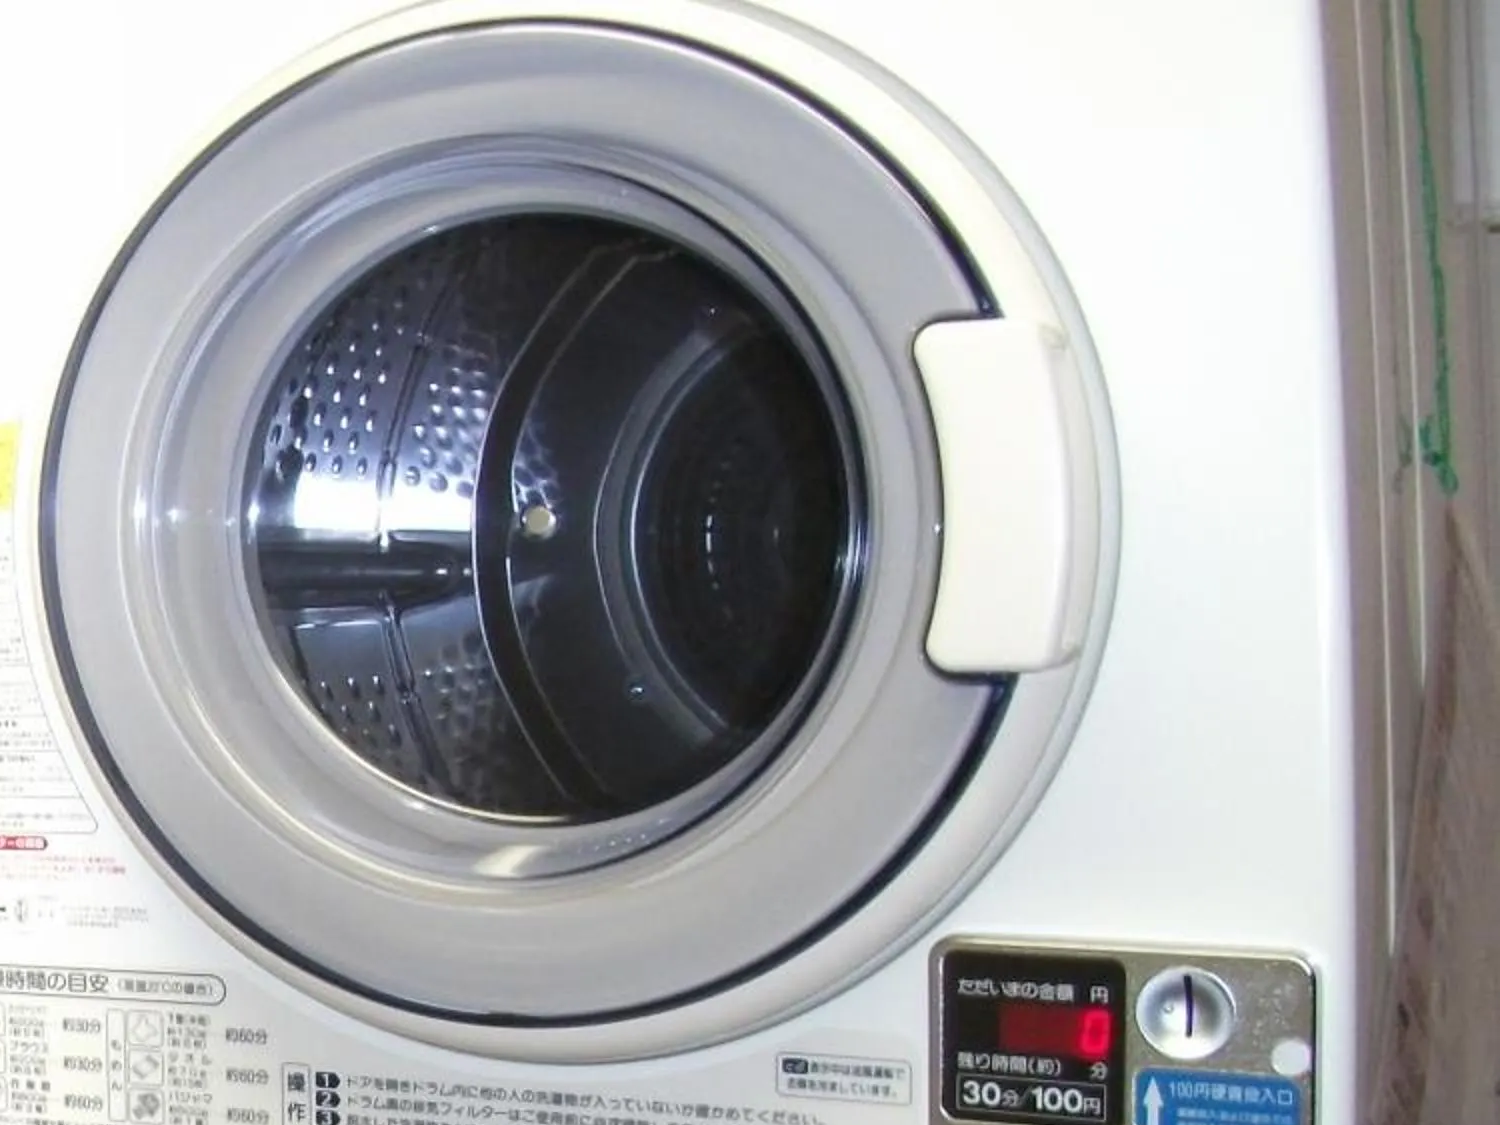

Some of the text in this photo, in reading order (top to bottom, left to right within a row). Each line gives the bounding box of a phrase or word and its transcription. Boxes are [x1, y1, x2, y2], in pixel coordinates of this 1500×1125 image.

[957, 977, 1109, 1004] ただいまの金額 円
[1079, 1008, 1111, 1058] 0
[957, 1050, 1109, 1080] 残り時間(約) 分
